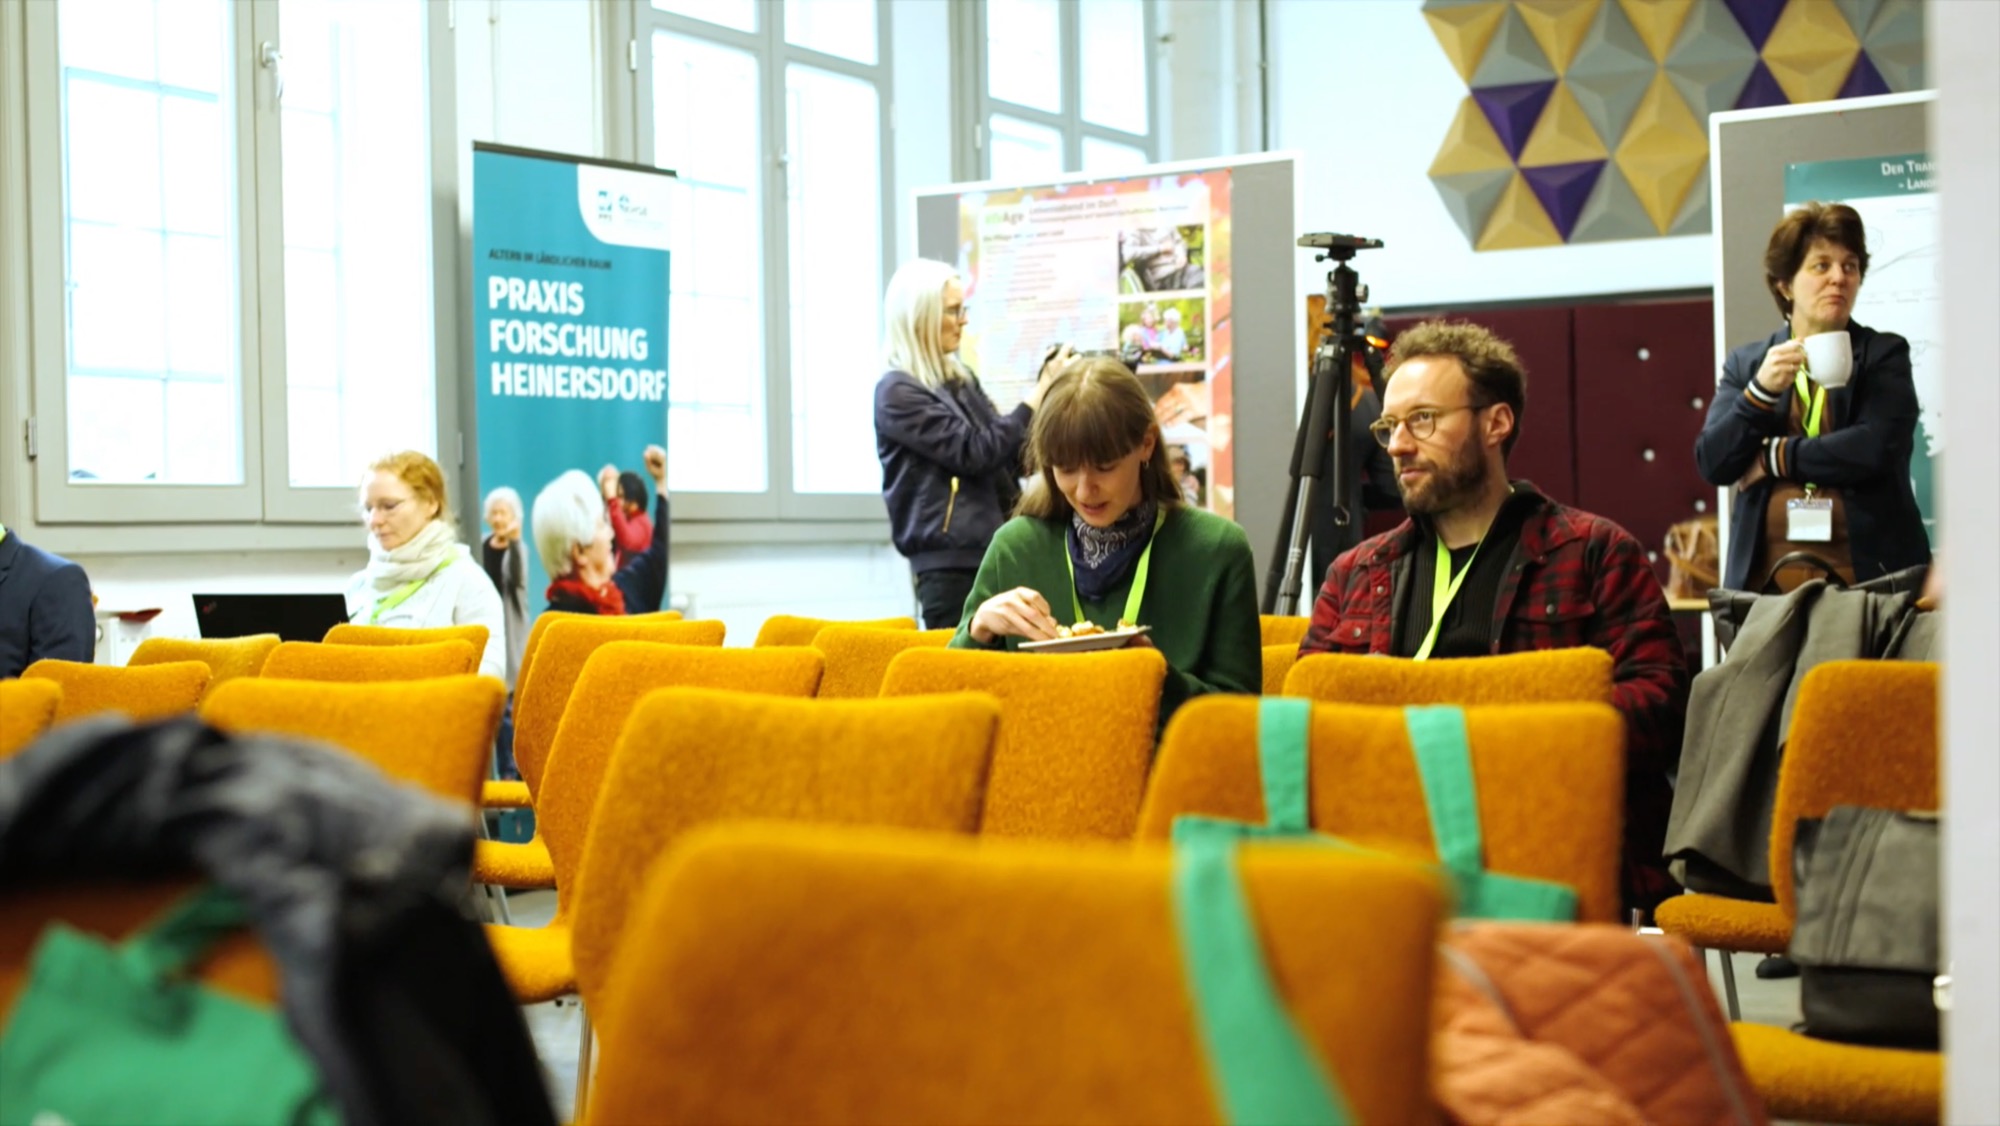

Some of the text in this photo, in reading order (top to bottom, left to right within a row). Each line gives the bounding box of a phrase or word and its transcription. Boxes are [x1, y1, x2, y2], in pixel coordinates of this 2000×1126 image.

[488, 275, 585, 316] PRAXIS
[489, 318, 649, 361] FORSCHUNG
[491, 361, 667, 401] HEINERSDORF
